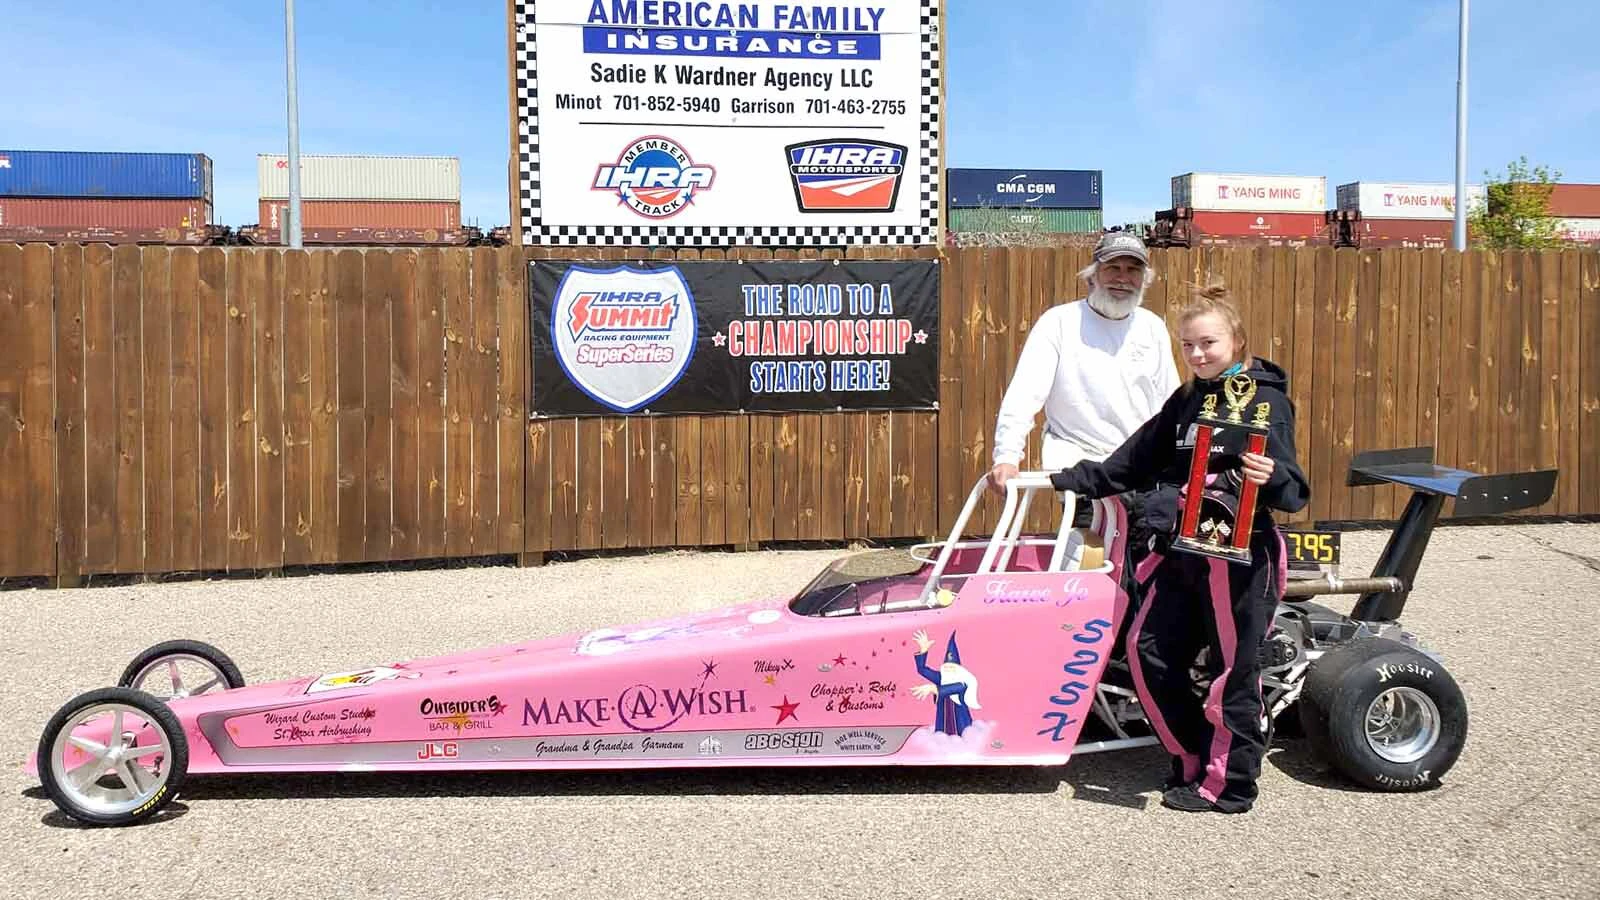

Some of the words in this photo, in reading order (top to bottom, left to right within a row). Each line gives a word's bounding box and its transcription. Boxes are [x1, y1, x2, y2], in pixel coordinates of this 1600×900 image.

[587, 0, 759, 29] AMERICAN
[773, 5, 886, 32] FAMILY
[606, 32, 858, 55] INSURANCE
[590, 62, 646, 85] Sadie
[654, 63, 667, 84] K
[675, 64, 757, 87] Wardner
[764, 67, 832, 91] Agency
[840, 68, 873, 88] LLC
[555, 93, 601, 110] Minot
[613, 95, 720, 113] 701-852-5940
[731, 98, 795, 114] Garrison
[805, 98, 906, 116] 701-463-2755
[624, 140, 687, 164] MEMBER
[800, 146, 894, 165] IHRA
[597, 166, 714, 188] IHRA
[797, 165, 896, 174] MOTORSPORTS
[996, 183, 1025, 193] CMA
[1027, 183, 1056, 194] CGM
[1232, 187, 1266, 198] YANG
[1268, 188, 1302, 199] MING
[634, 199, 681, 217] TRACK
[1396, 195, 1427, 206] YANG
[599, 291, 662, 302] IHRA
[742, 285, 786, 316] THE
[787, 285, 841, 316] ROAD
[845, 284, 874, 315] TO
[877, 284, 893, 314] A
[727, 319, 913, 357] CHAMPIONSHIP
[577, 344, 673, 367] SuperSeries
[750, 361, 825, 393] STARTS
[831, 360, 891, 392] HERE!
[1287, 533, 1333, 561] 7.95
[1375, 662, 1434, 683] Hoosier
[810, 683, 863, 698] Chopper's
[868, 681, 897, 694] Rods
[825, 702, 834, 712] &
[838, 700, 884, 713] Customs
[264, 712, 299, 724] Wizard
[302, 710, 336, 724] Custom
[429, 722, 449, 731] BAR
[464, 719, 494, 730] GRILL
[273, 728, 289, 740] St.
[292, 726, 315, 739] Croix
[318, 724, 372, 738] Airbrushing
[848, 730, 863, 738] WELL
[864, 731, 887, 745] SERVICE
[418, 743, 458, 759] JLC
[535, 741, 579, 753] Grandma
[582, 741, 591, 751] &
[592, 739, 634, 754] Grandpa
[1375, 770, 1431, 787] Hoosier
